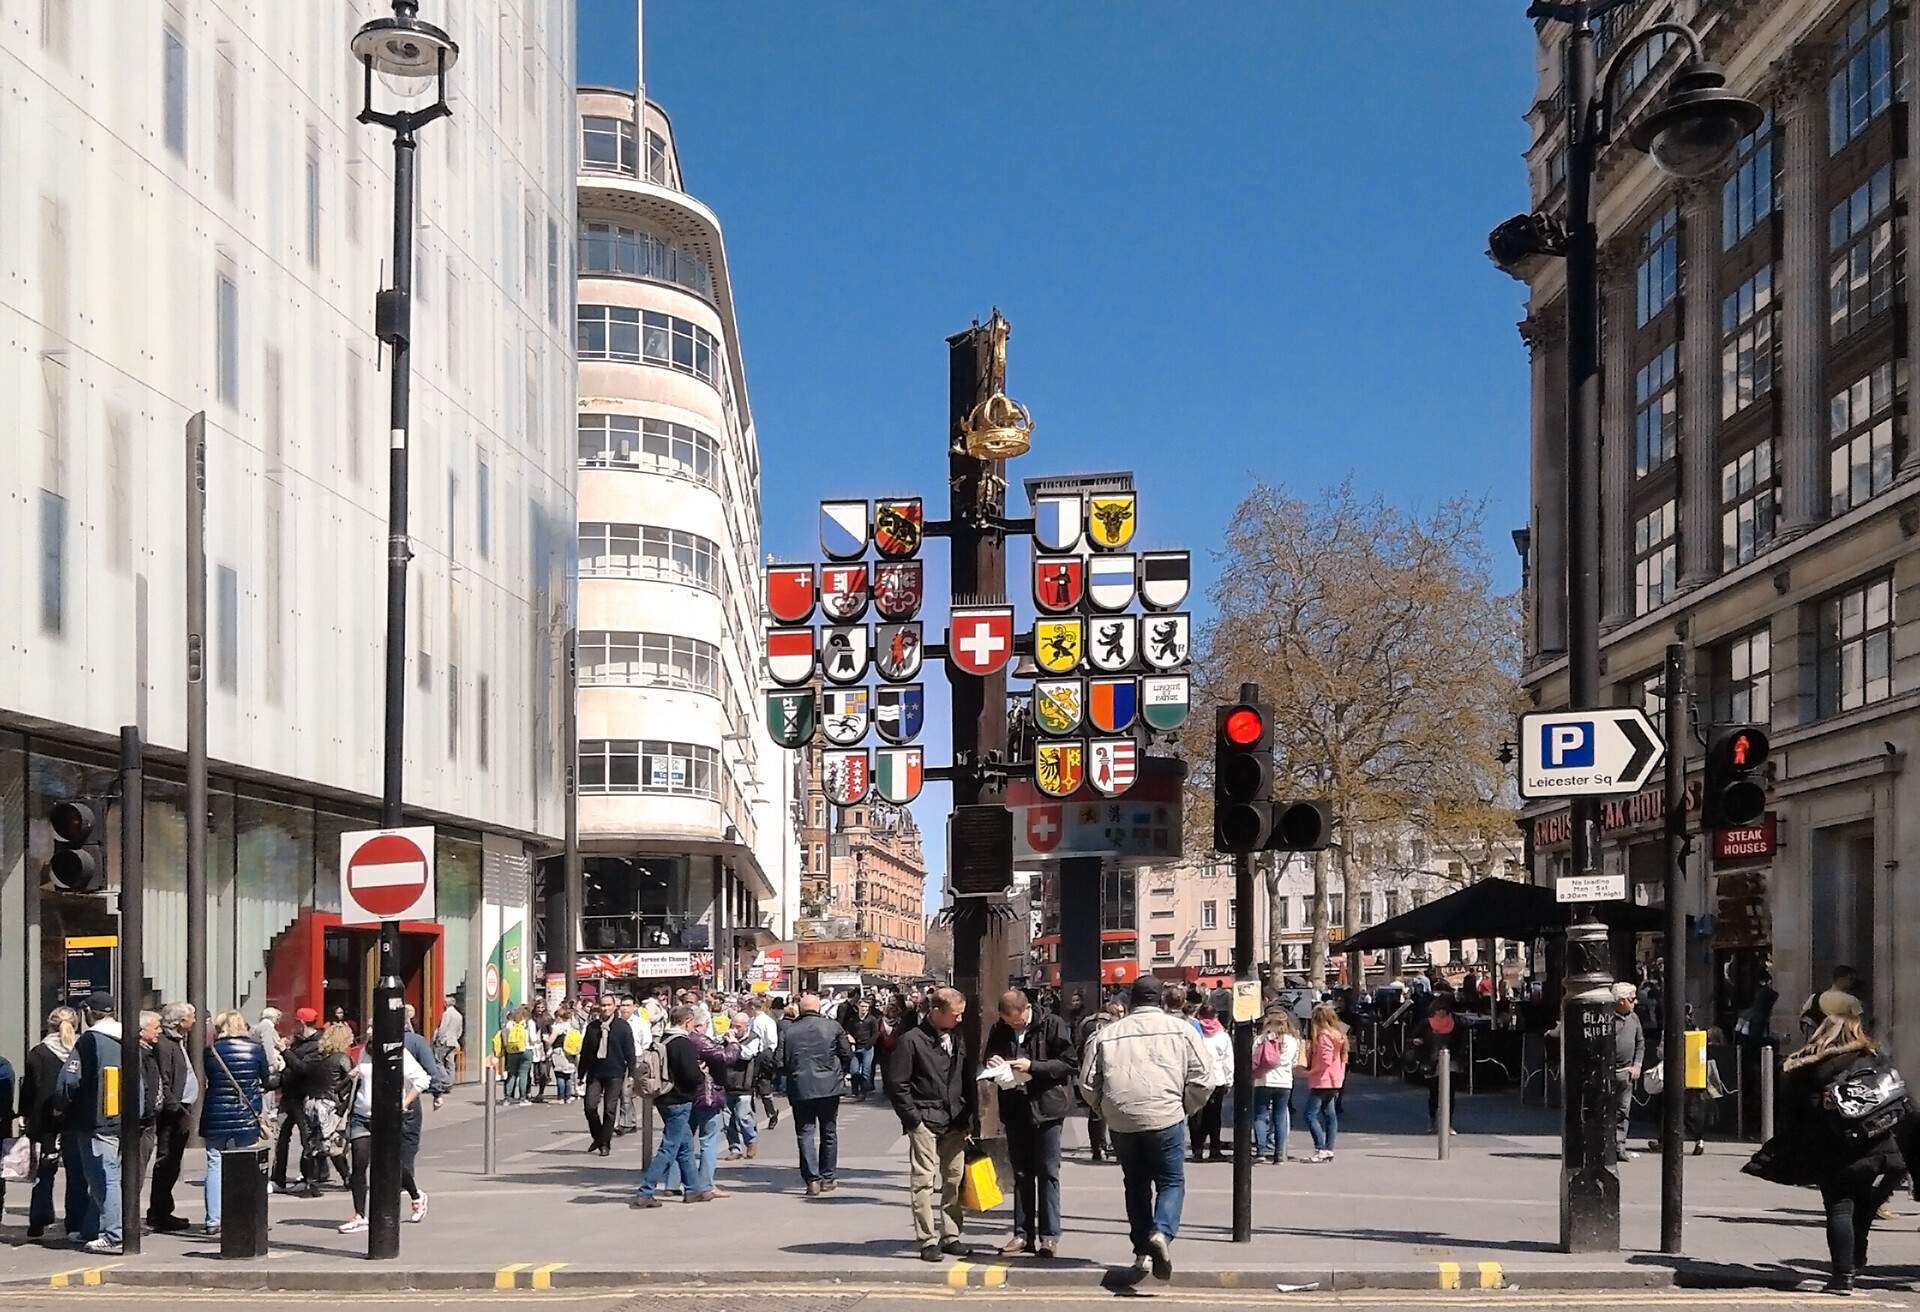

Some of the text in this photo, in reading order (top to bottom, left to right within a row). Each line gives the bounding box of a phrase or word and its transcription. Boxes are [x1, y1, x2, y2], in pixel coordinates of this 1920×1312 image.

[1178, 644, 1185, 652] R
[1552, 726, 1584, 765] P
[1528, 774, 1612, 788] Leicester Sq
[1534, 814, 1572, 848] ANGUS
[1728, 830, 1762, 842] STEAK
[1724, 842, 1767, 855] HOUSES
[1199, 966, 1224, 976] Pizza
